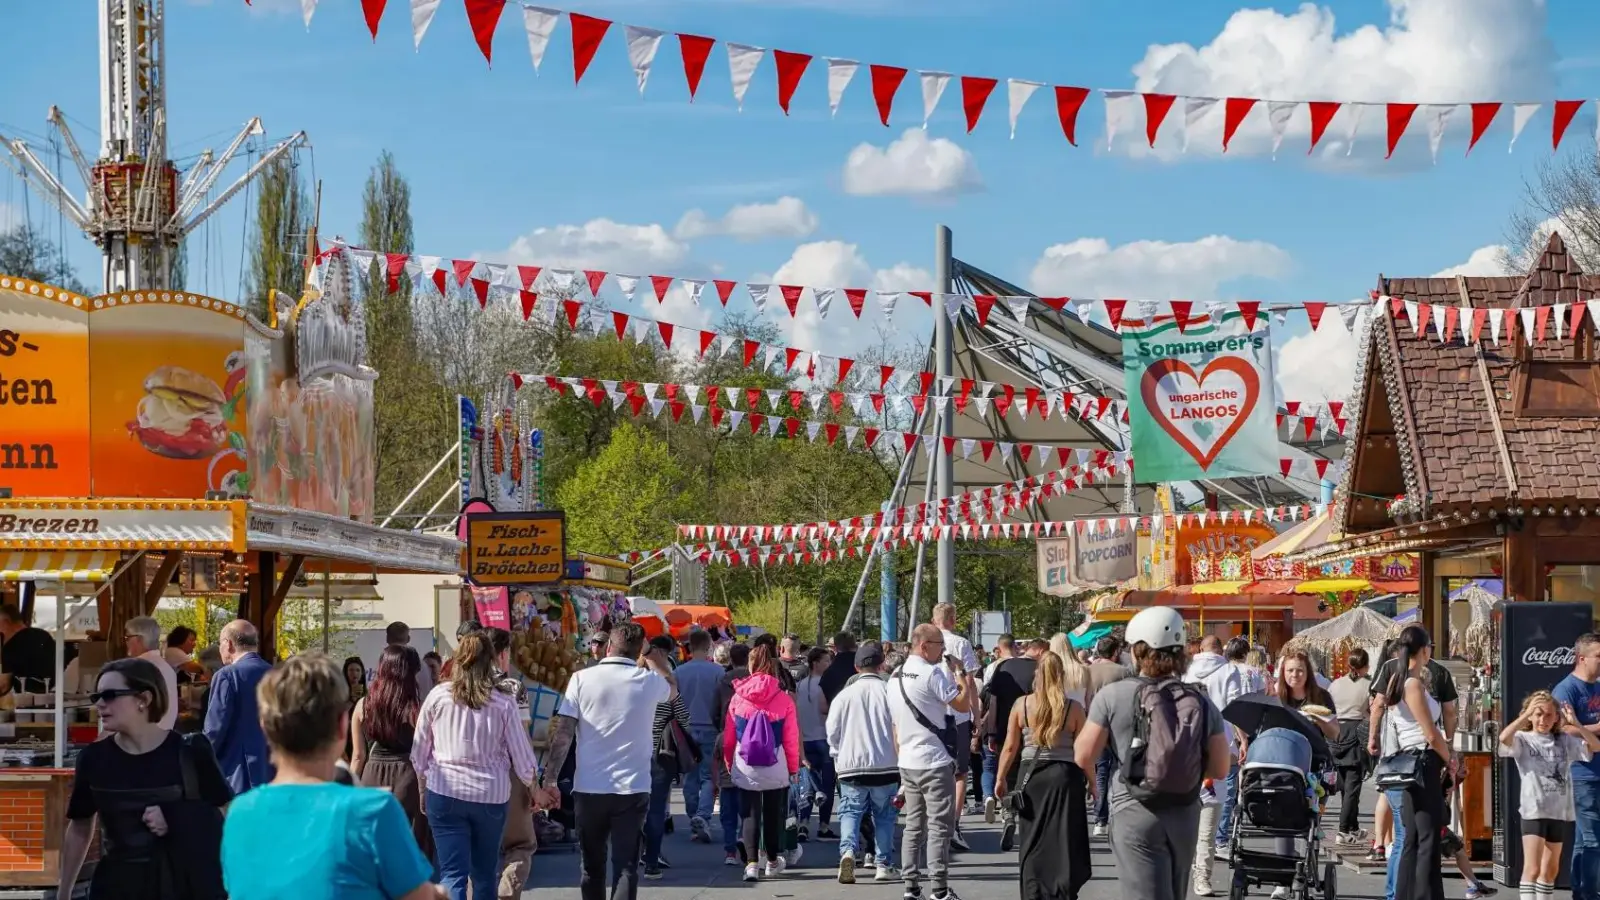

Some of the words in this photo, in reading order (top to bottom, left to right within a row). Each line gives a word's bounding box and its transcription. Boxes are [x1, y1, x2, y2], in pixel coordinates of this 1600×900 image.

[1168, 389, 1238, 404] ungarische
[1170, 404, 1238, 420] LANGOS
[0, 514, 99, 533] Brezen
[487, 524, 547, 539] Fisch-
[1080, 543, 1133, 564] POPCORN
[473, 560, 560, 575] Brötchen
